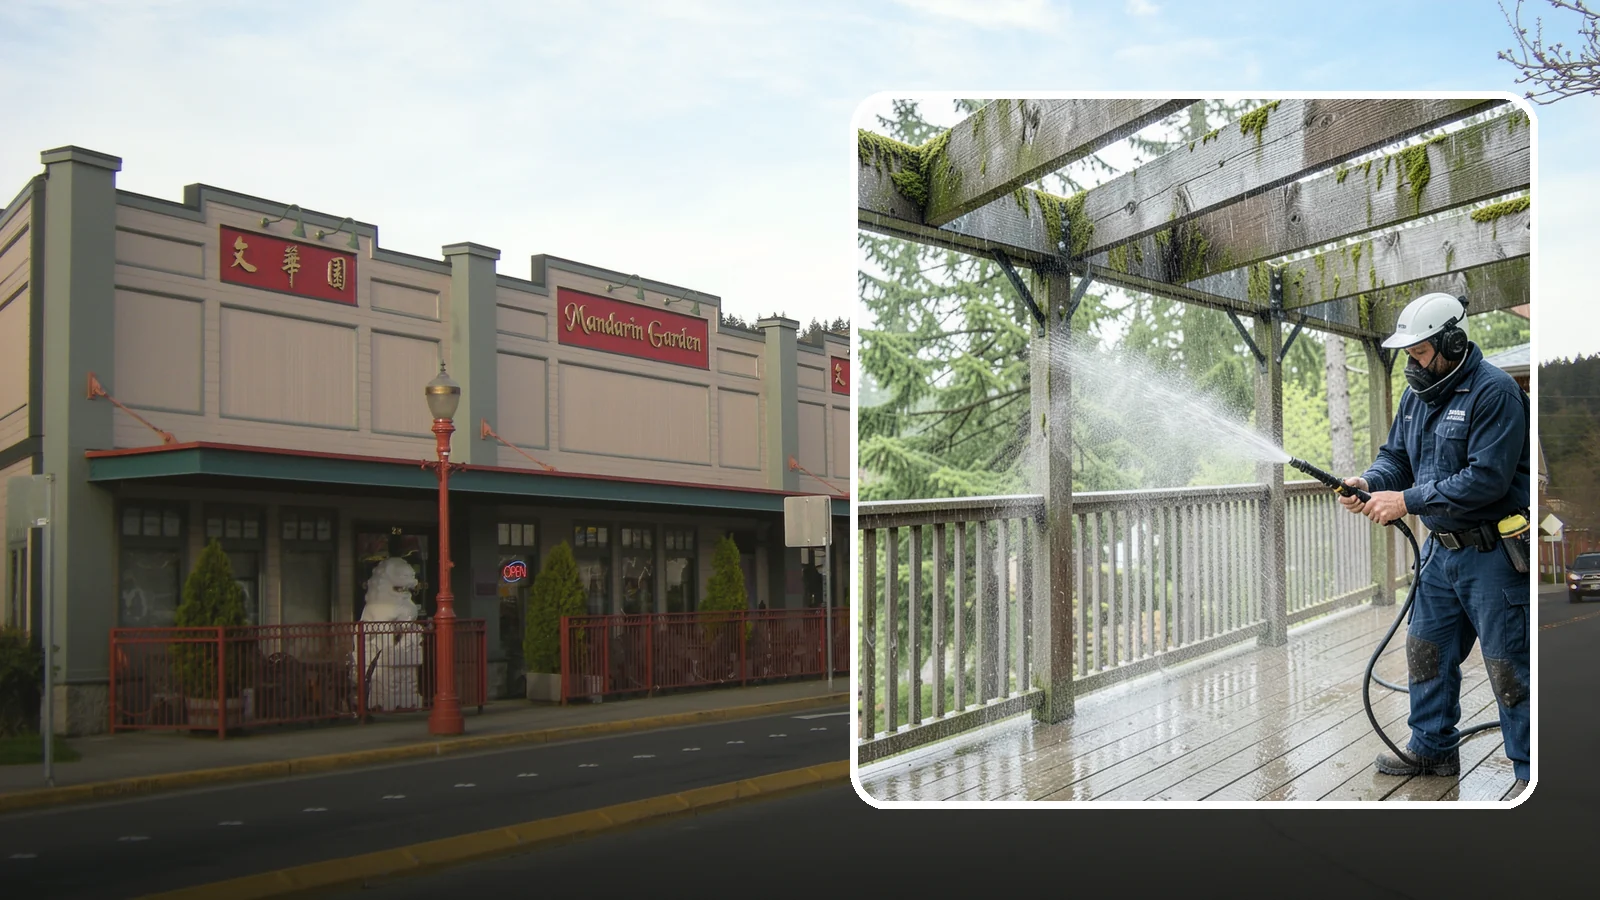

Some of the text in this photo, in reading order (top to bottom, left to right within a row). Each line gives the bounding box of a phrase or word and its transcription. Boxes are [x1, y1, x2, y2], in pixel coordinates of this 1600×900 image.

[564, 302, 701, 352] Mandarin Garden
[503, 565, 527, 579] OPEN
